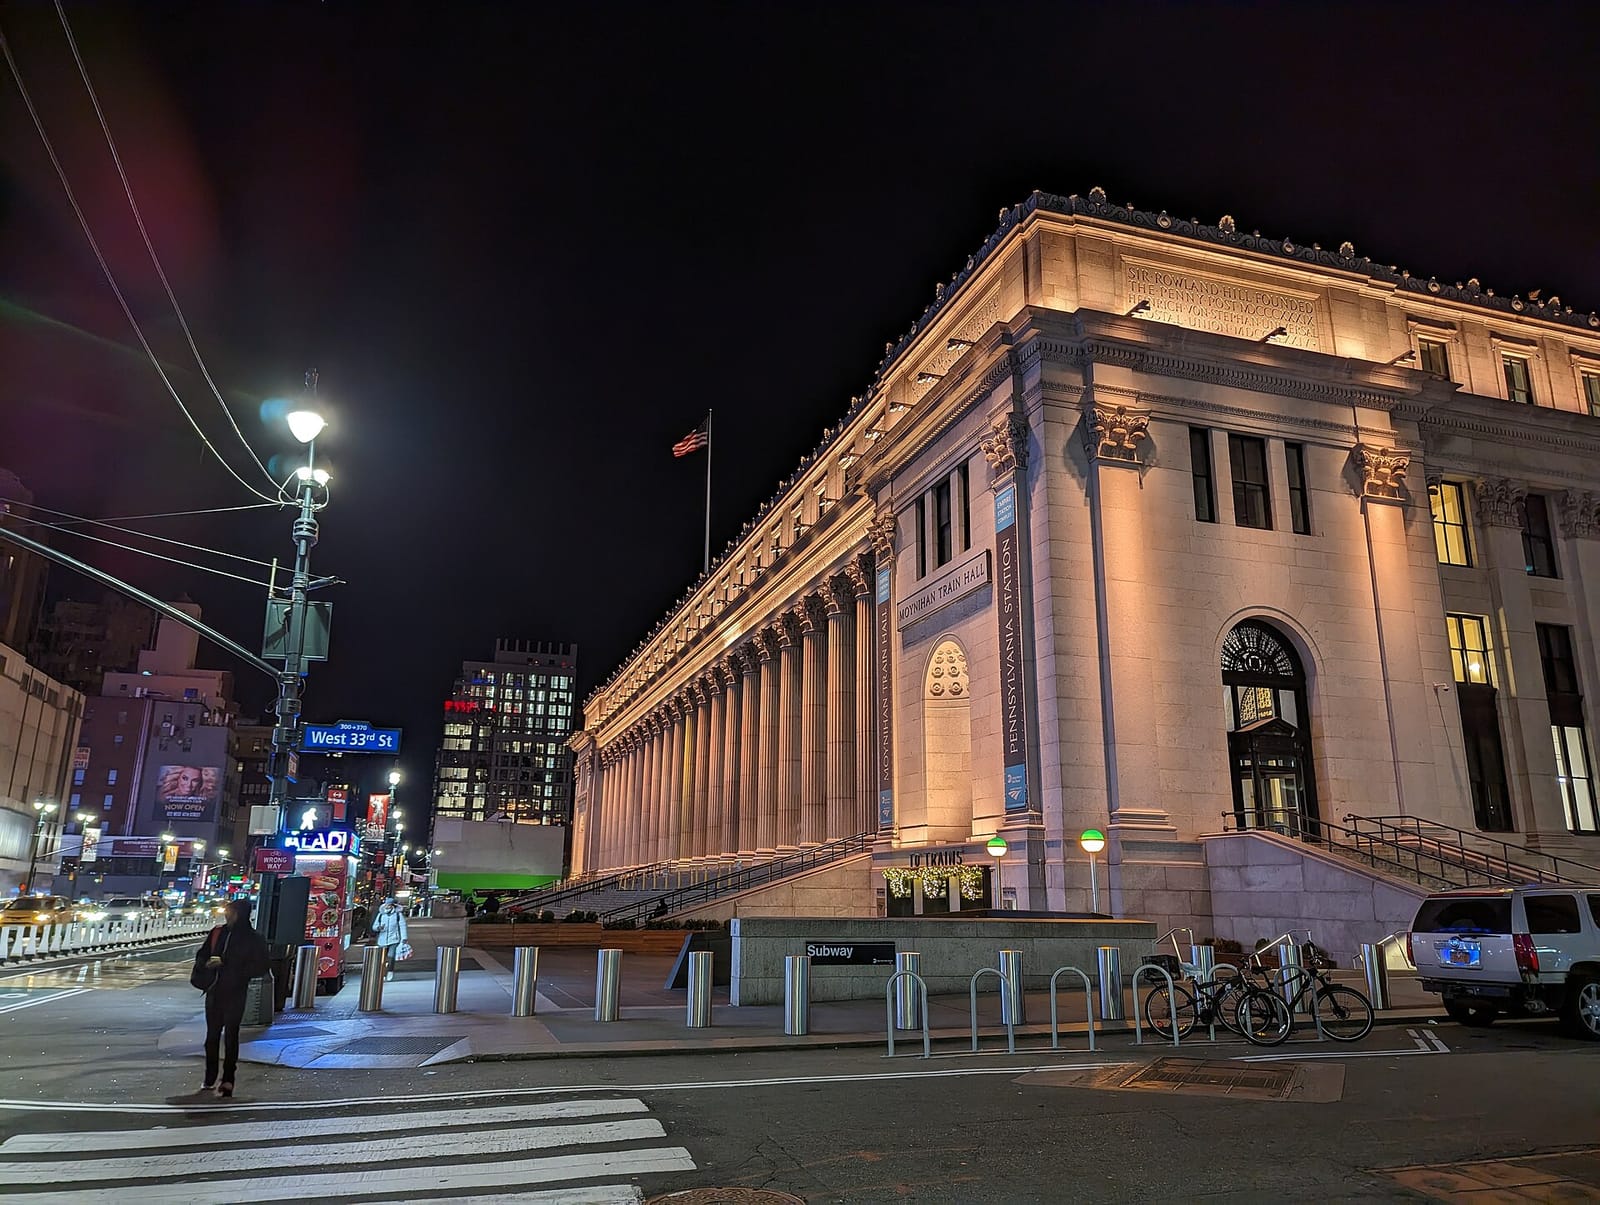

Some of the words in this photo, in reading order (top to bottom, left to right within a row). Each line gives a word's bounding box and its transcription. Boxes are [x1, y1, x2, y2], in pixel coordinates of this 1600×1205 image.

[1128, 266, 1150, 282] SIR
[1154, 271, 1219, 296] ROWLAND
[1223, 285, 1251, 302] HILL
[1256, 292, 1313, 314] FOUNDED
[1128, 280, 1155, 296] THE
[1160, 286, 1204, 304] PENNY
[1208, 295, 1238, 311] POST
[1128, 293, 1182, 312] HENRICH
[1188, 304, 1208, 317] VON
[1210, 309, 1258, 326] STEPHAN
[1140, 309, 1184, 325] OSTAL
[1189, 317, 1229, 332] UNION
[1002, 538, 1013, 614] STATION
[899, 591, 936, 621] MOYNIHAN
[938, 576, 961, 599] TRAIN
[963, 563, 985, 585] HALL
[1005, 618, 1018, 753] PENNSYLVANIA
[311, 731, 347, 745] West
[349, 733, 376, 746] 33rd
[378, 734, 393, 747] St
[263, 856, 288, 864] WRONG
[909, 852, 921, 868] TO
[923, 850, 963, 867] TRAINS
[807, 944, 853, 959] Subway
